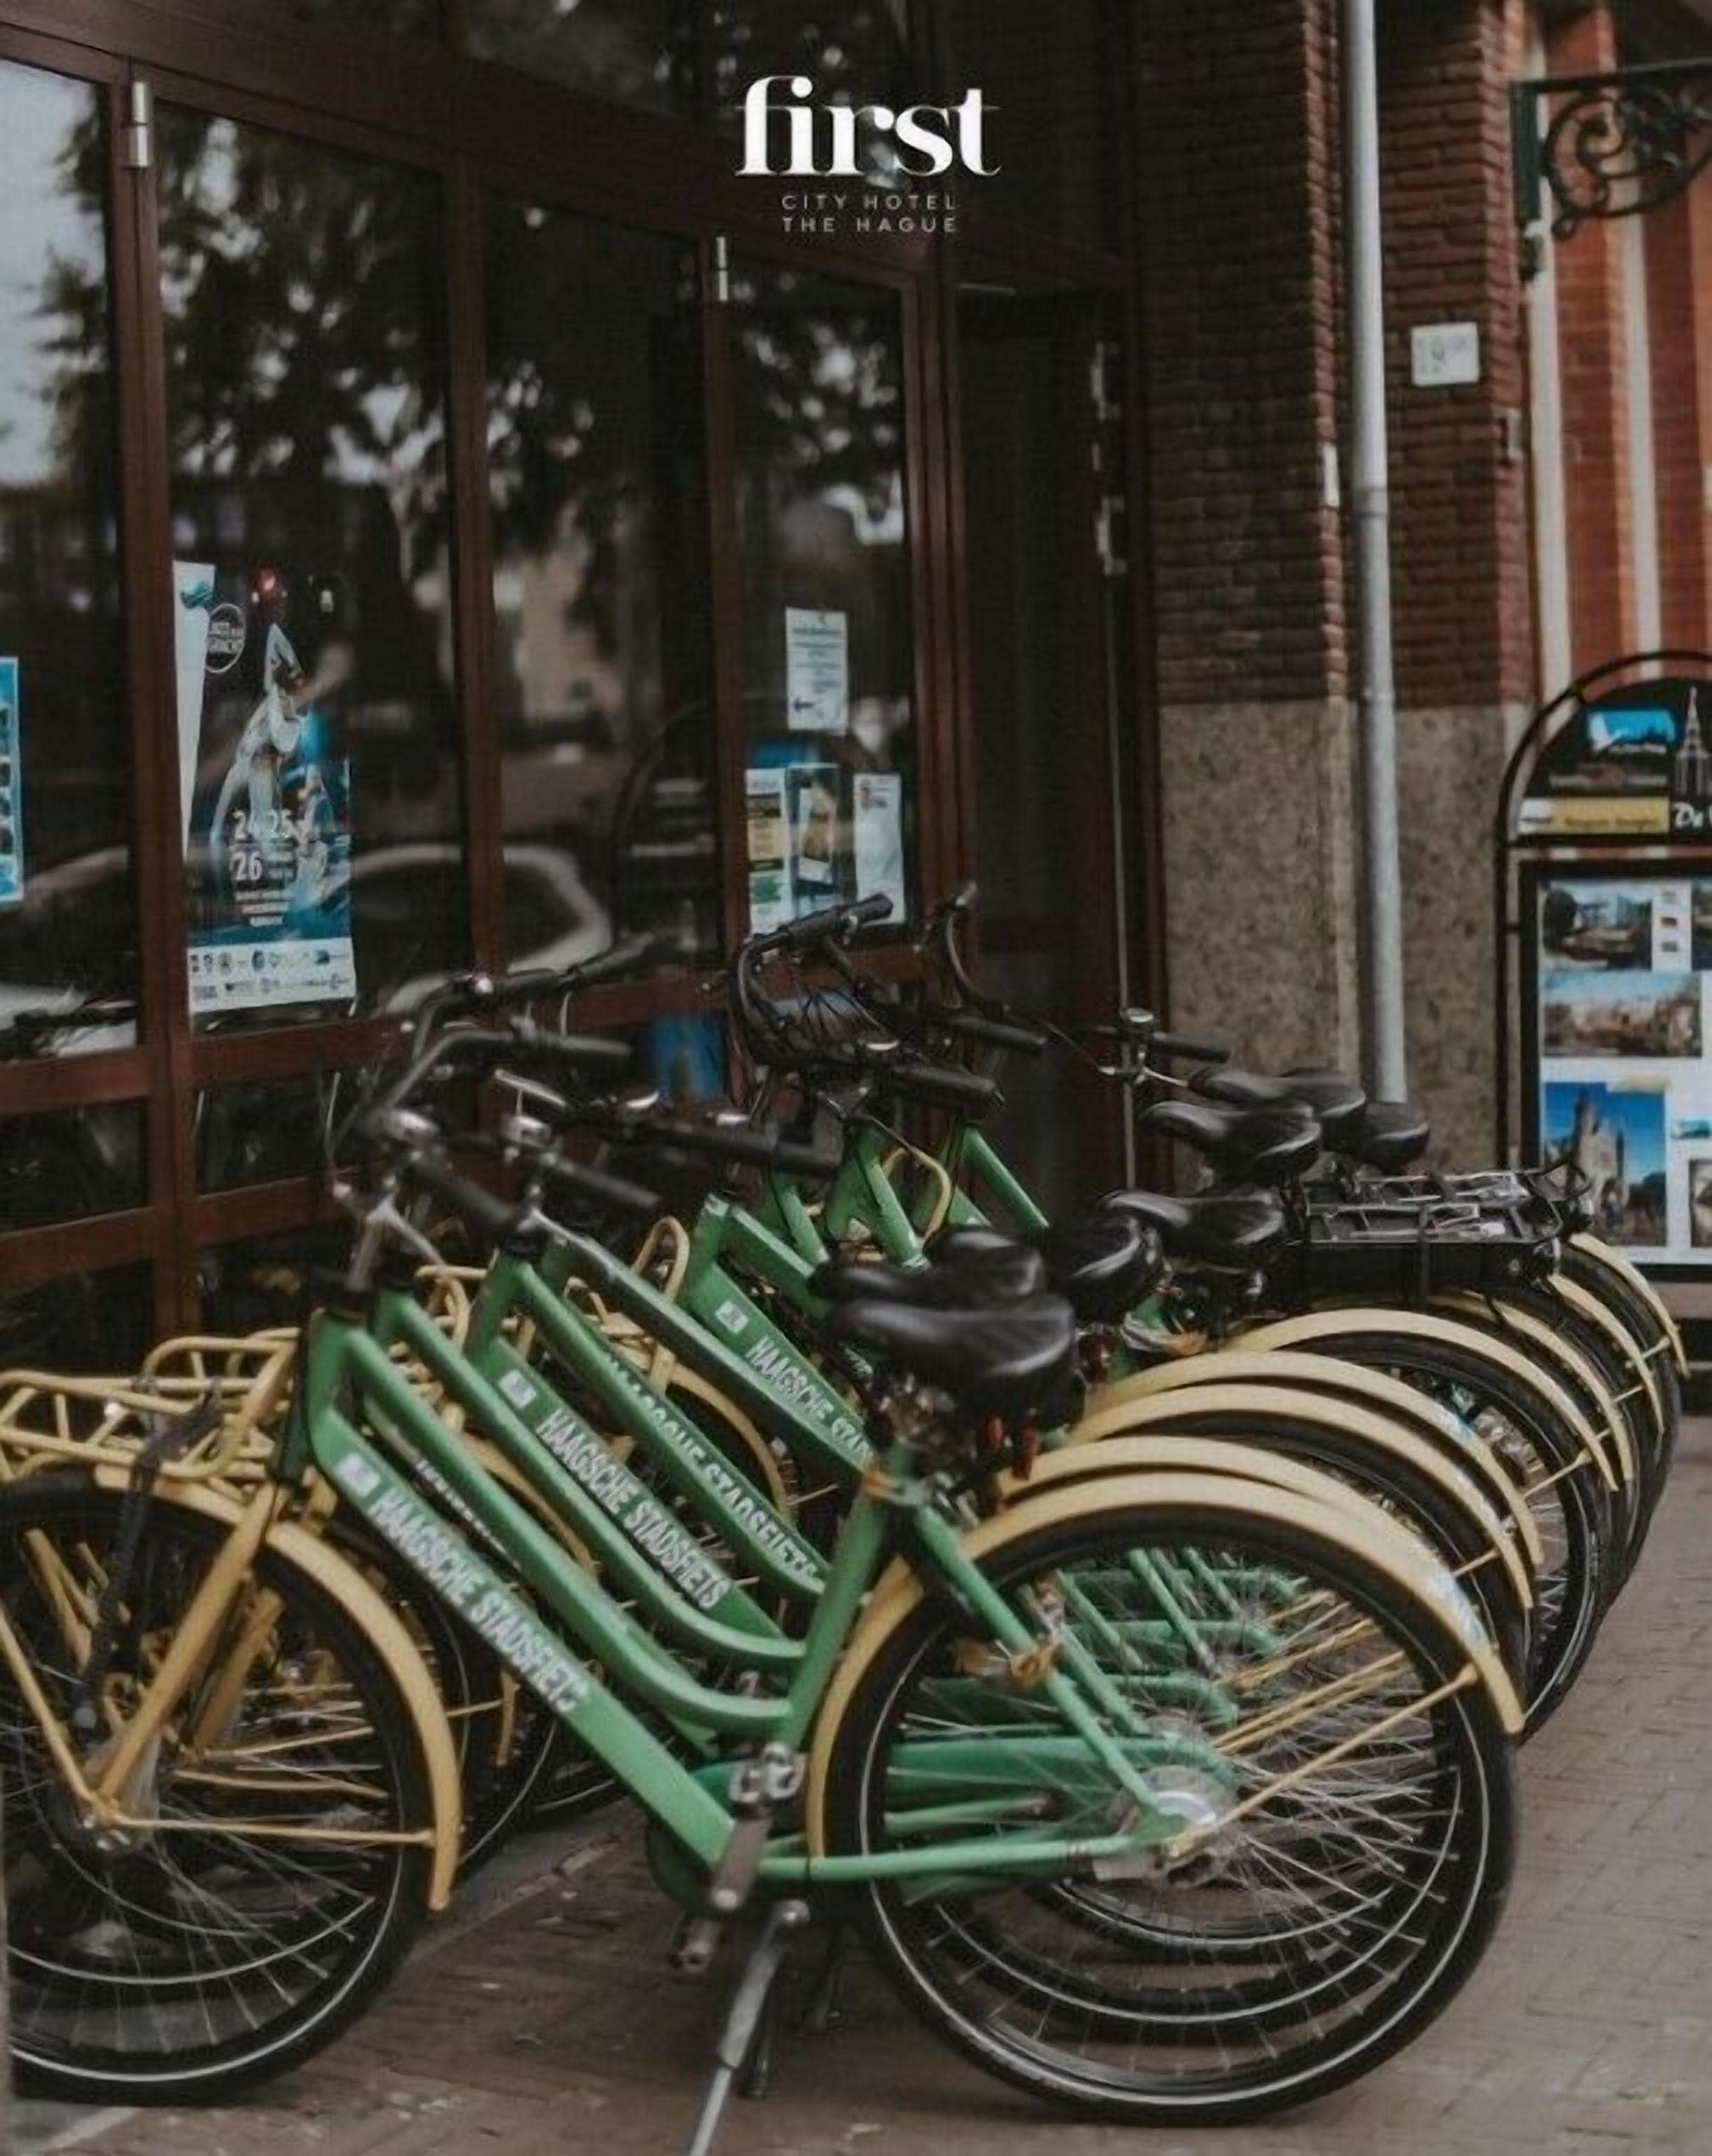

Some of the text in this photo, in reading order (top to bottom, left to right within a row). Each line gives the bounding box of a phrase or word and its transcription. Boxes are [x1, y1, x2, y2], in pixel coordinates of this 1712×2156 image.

[368, 1485, 485, 1605] HAAGSCHE
[536, 1407, 732, 1609] HAAGSCHE STADSFIETS
